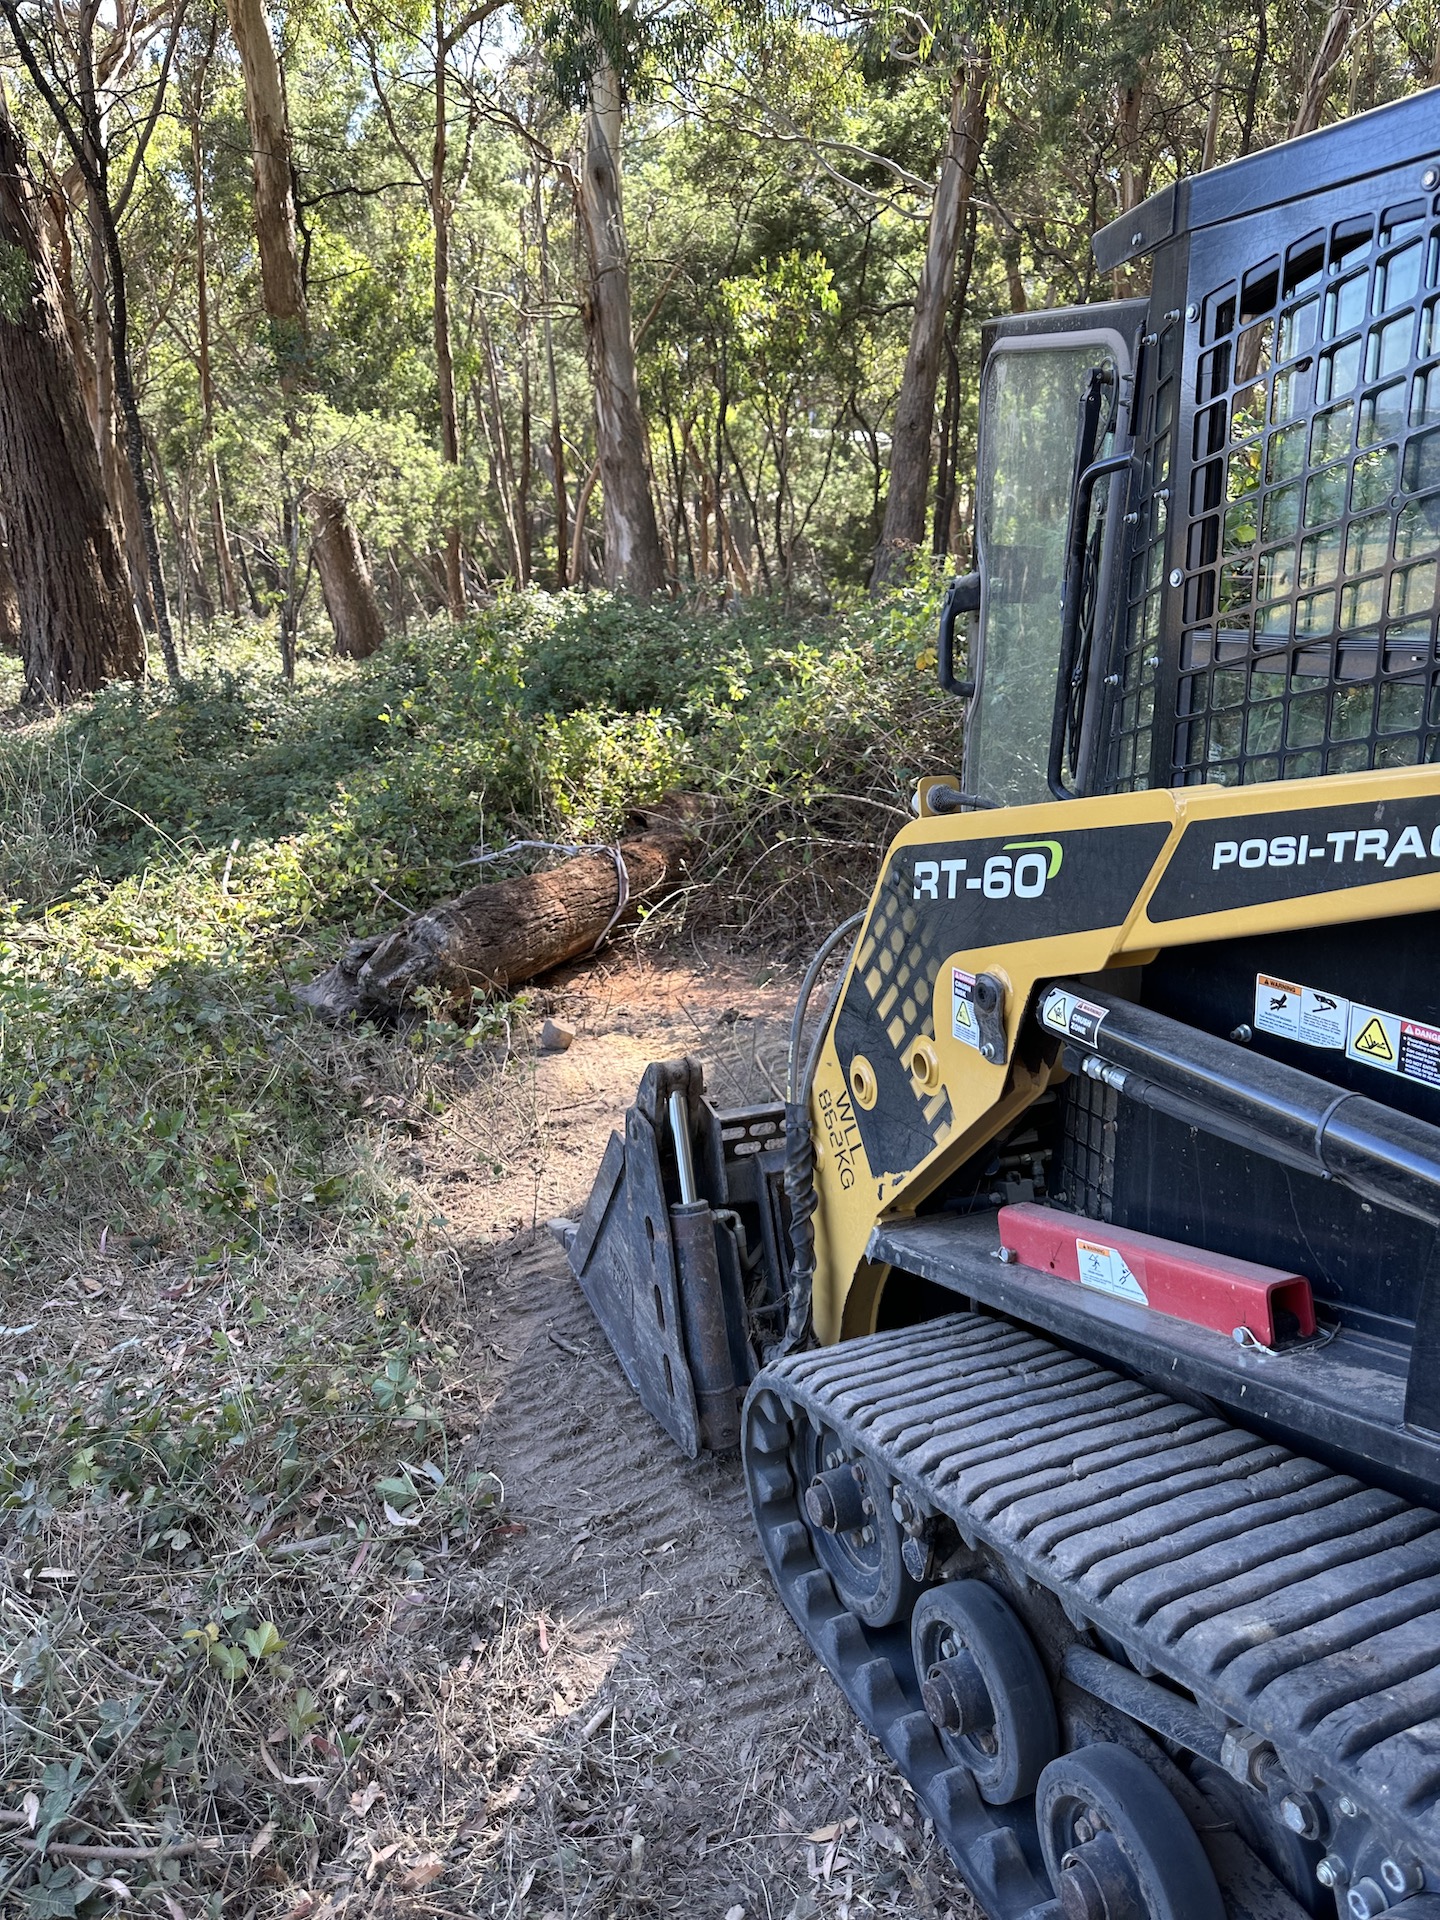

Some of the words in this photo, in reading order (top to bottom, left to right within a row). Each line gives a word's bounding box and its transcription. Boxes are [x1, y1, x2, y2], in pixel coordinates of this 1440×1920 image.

[1212, 825, 1440, 870] POSI-TRA
[913, 853, 1047, 900] RT-60
[1270, 980, 1296, 993] WARNING
[1070, 1021, 1087, 1035] ZONE
[1072, 1013, 1093, 1028] CRUSH
[1414, 1027, 1440, 1042] DANGE
[836, 1090, 862, 1165] WLL
